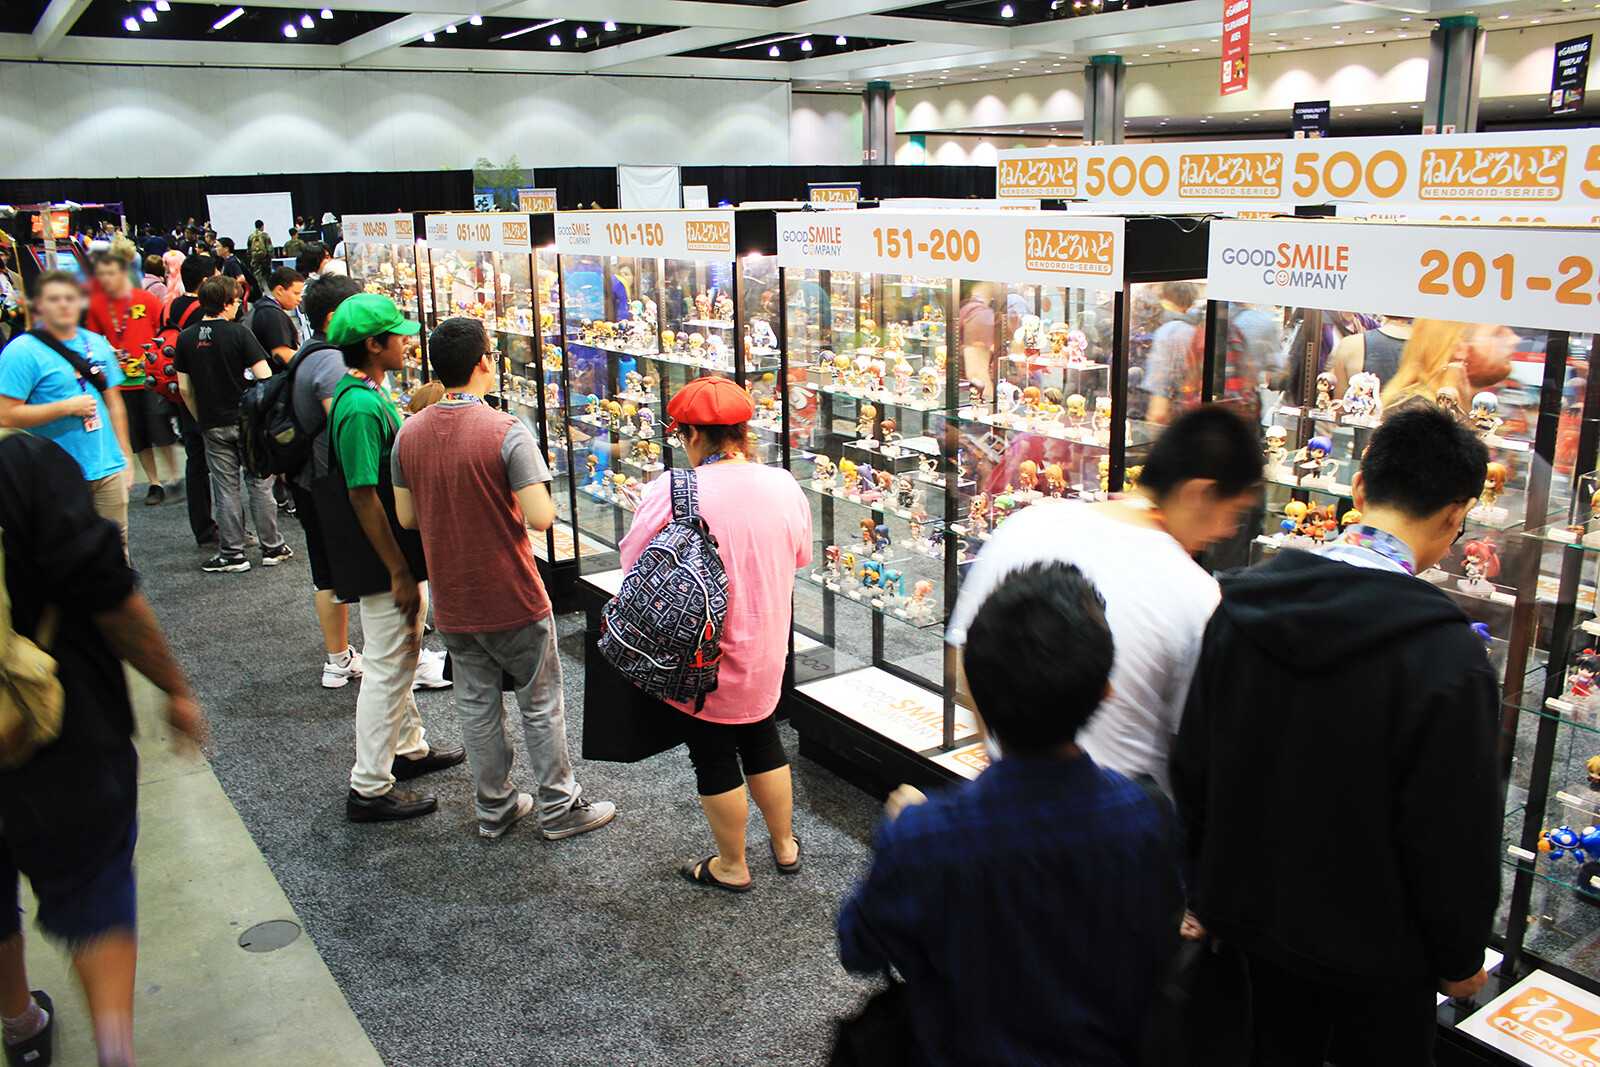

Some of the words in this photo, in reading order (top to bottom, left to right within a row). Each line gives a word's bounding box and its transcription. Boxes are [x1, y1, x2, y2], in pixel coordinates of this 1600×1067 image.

[1558, 41, 1588, 57] eGAMING
[1000, 158, 1077, 186] ねんどろいど
[1085, 155, 1170, 197] 500
[1181, 155, 1282, 185] ねんどろいど
[1292, 150, 1408, 198] 500
[1422, 148, 1565, 185] ねんどろいど
[362, 221, 388, 237] 000-050
[457, 223, 491, 242] 051-100
[569, 236, 591, 245] COMPANY
[605, 222, 664, 247] 101-150
[802, 244, 842, 256] COMPANY
[872, 227, 981, 263] 151-200
[1027, 231, 1113, 262] ねんどろいど
[1263, 269, 1348, 291] COMPANY
[1418, 249, 1600, 305] 201-2
